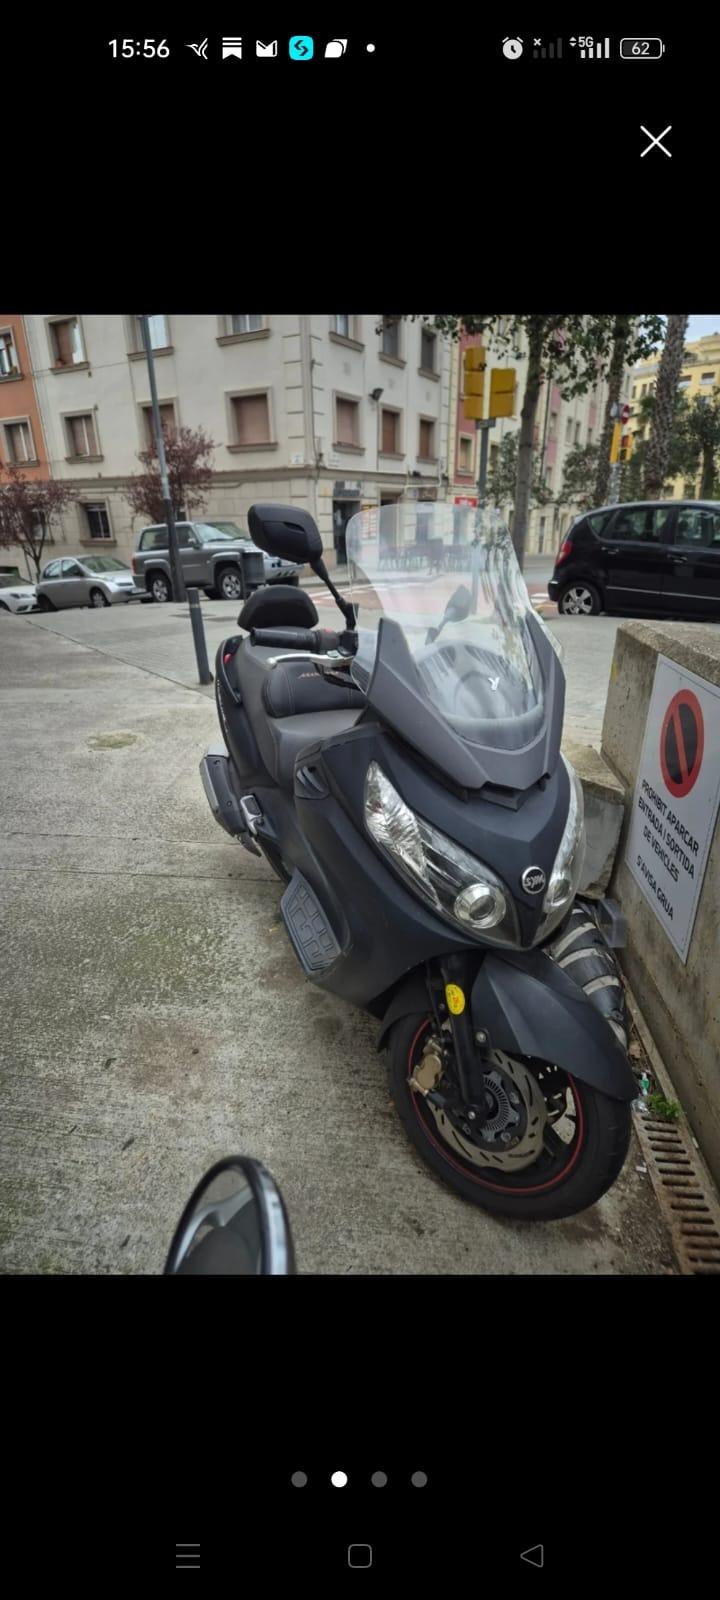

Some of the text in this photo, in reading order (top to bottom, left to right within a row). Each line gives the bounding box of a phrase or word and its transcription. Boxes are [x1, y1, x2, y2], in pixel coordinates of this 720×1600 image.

[638, 796, 663, 838] ENTRADA
[665, 833, 695, 879] SORTIDA
[641, 779, 700, 857] PROHIBIT APARCAR
[524, 867, 544, 889] SYM
[643, 825, 681, 882] DE VEHICLES
[636, 855, 674, 920] S'AVISA GRUA
